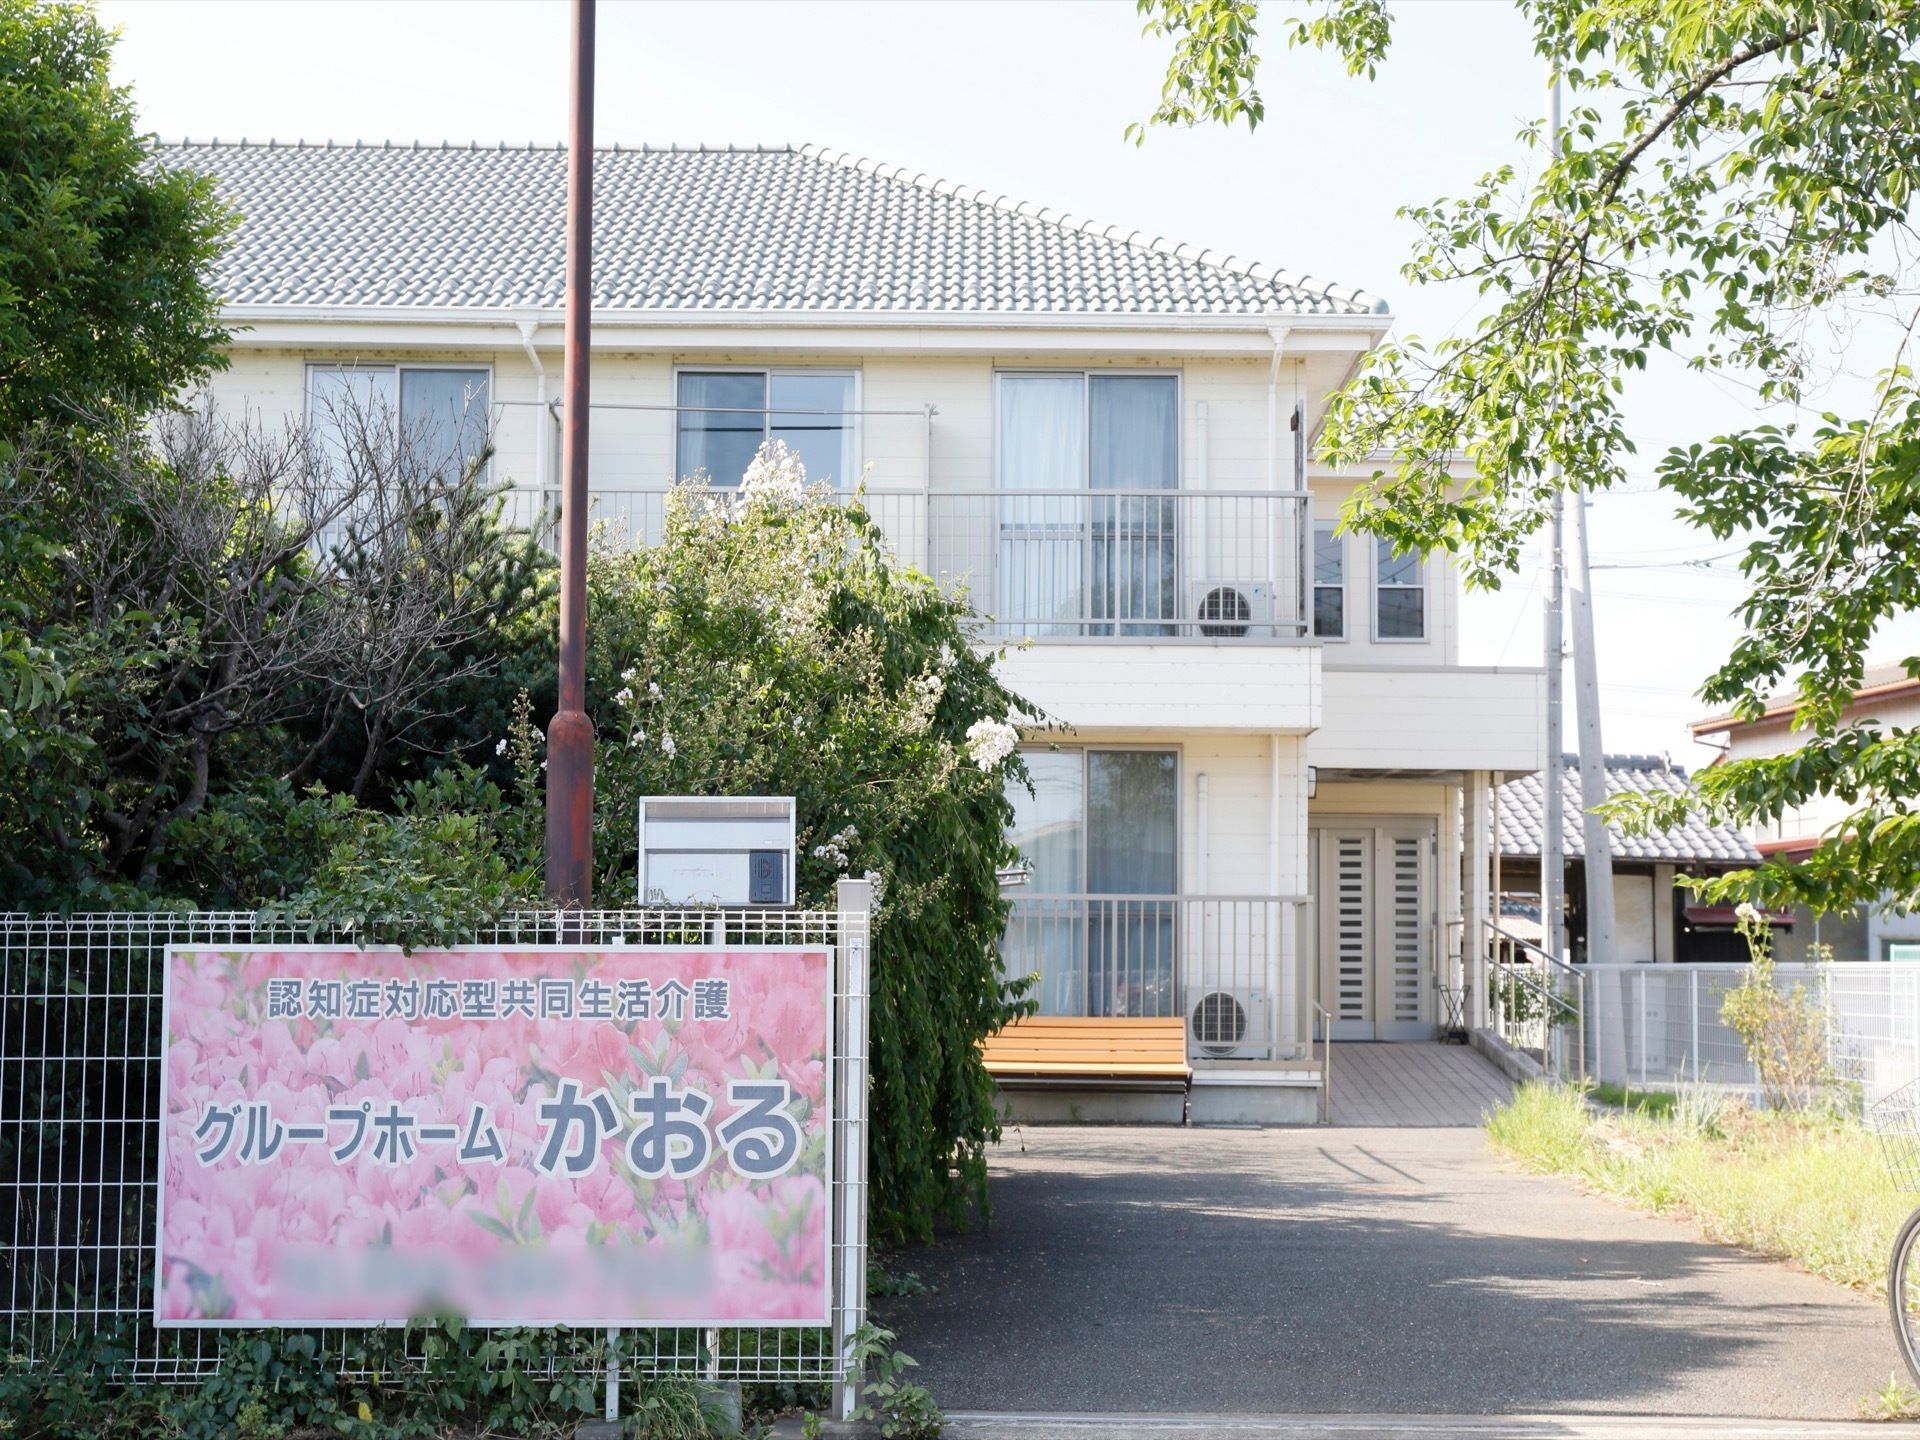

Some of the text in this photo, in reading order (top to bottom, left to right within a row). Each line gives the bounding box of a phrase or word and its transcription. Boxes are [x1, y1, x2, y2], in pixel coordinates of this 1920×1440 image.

[268, 979, 730, 1019] 認知症対応型共同生活介護
[196, 1080, 799, 1175] グループホーム かおる
